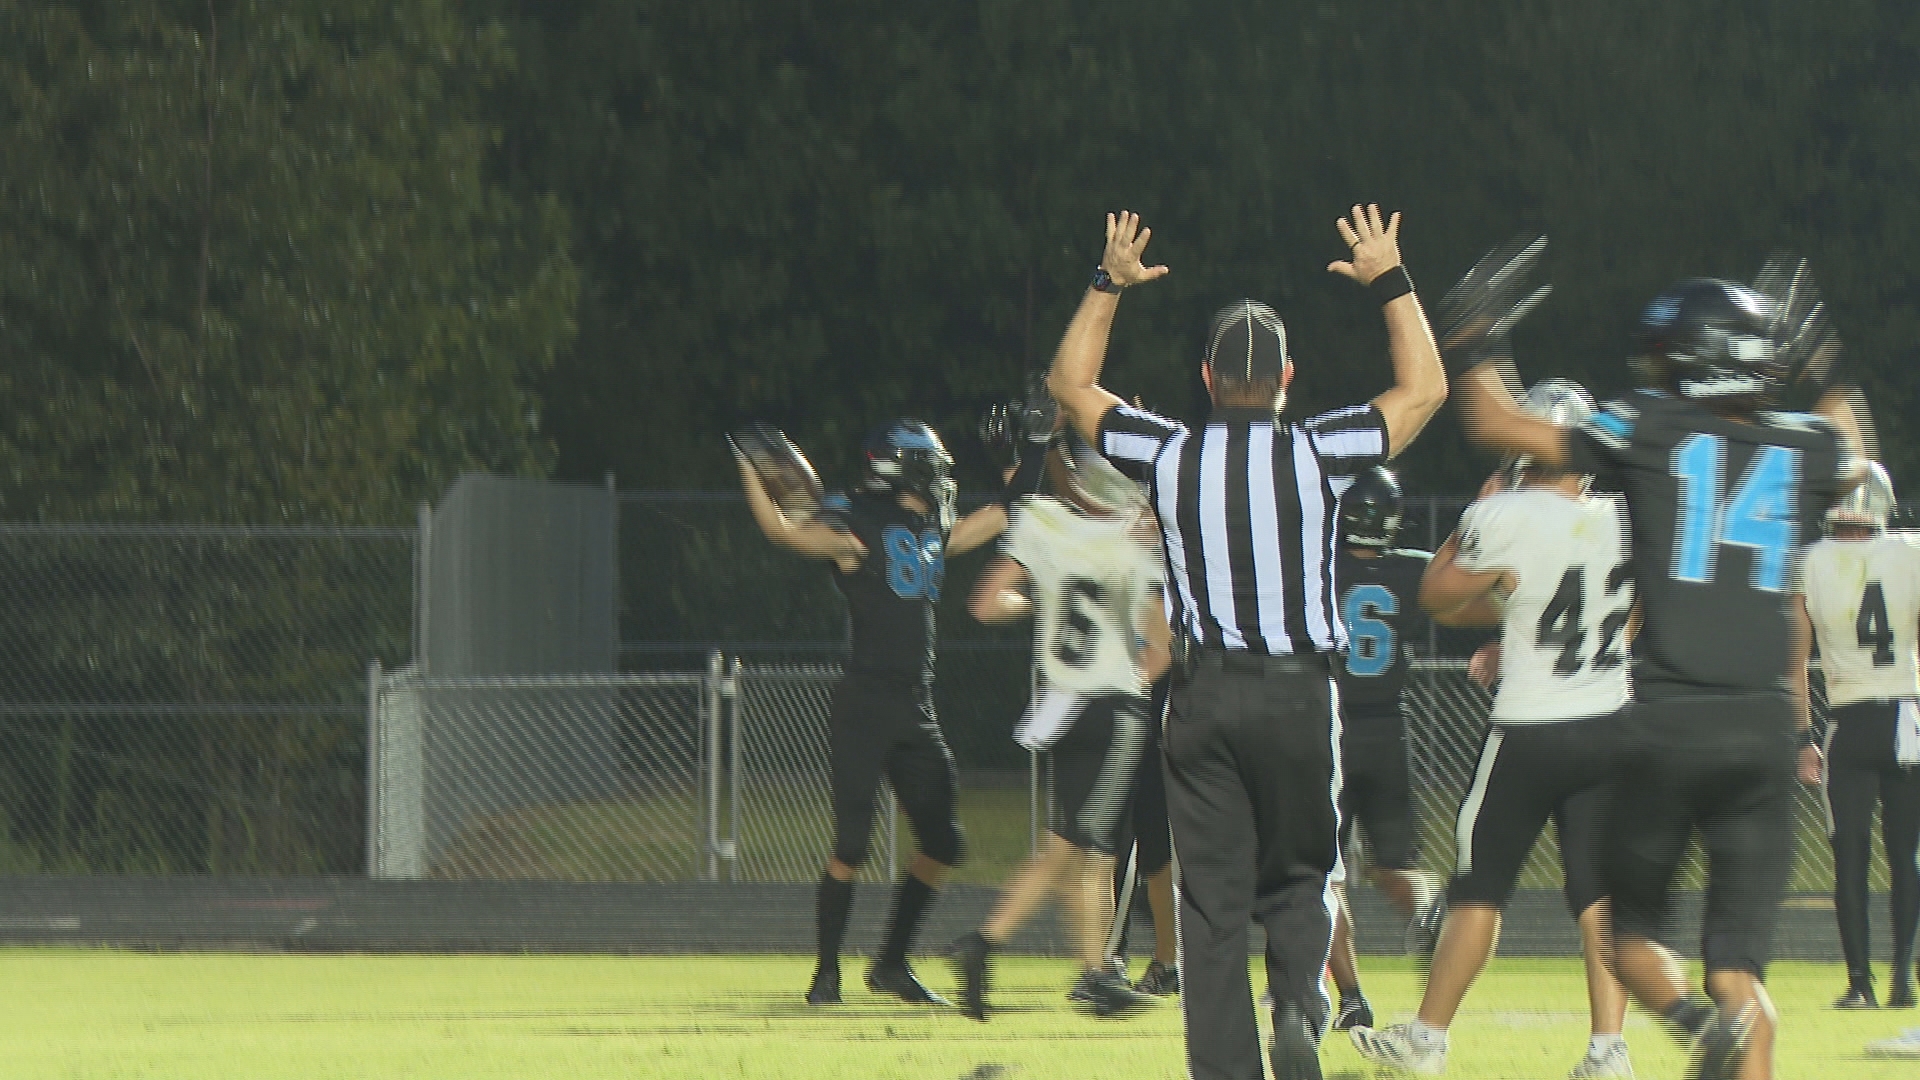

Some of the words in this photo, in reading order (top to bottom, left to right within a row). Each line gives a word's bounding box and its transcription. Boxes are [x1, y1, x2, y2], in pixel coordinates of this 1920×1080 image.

[1668, 432, 1803, 593] 14
[1341, 584, 1400, 676] 6
[1534, 562, 1636, 677] 42
[1856, 579, 1895, 667] 4
